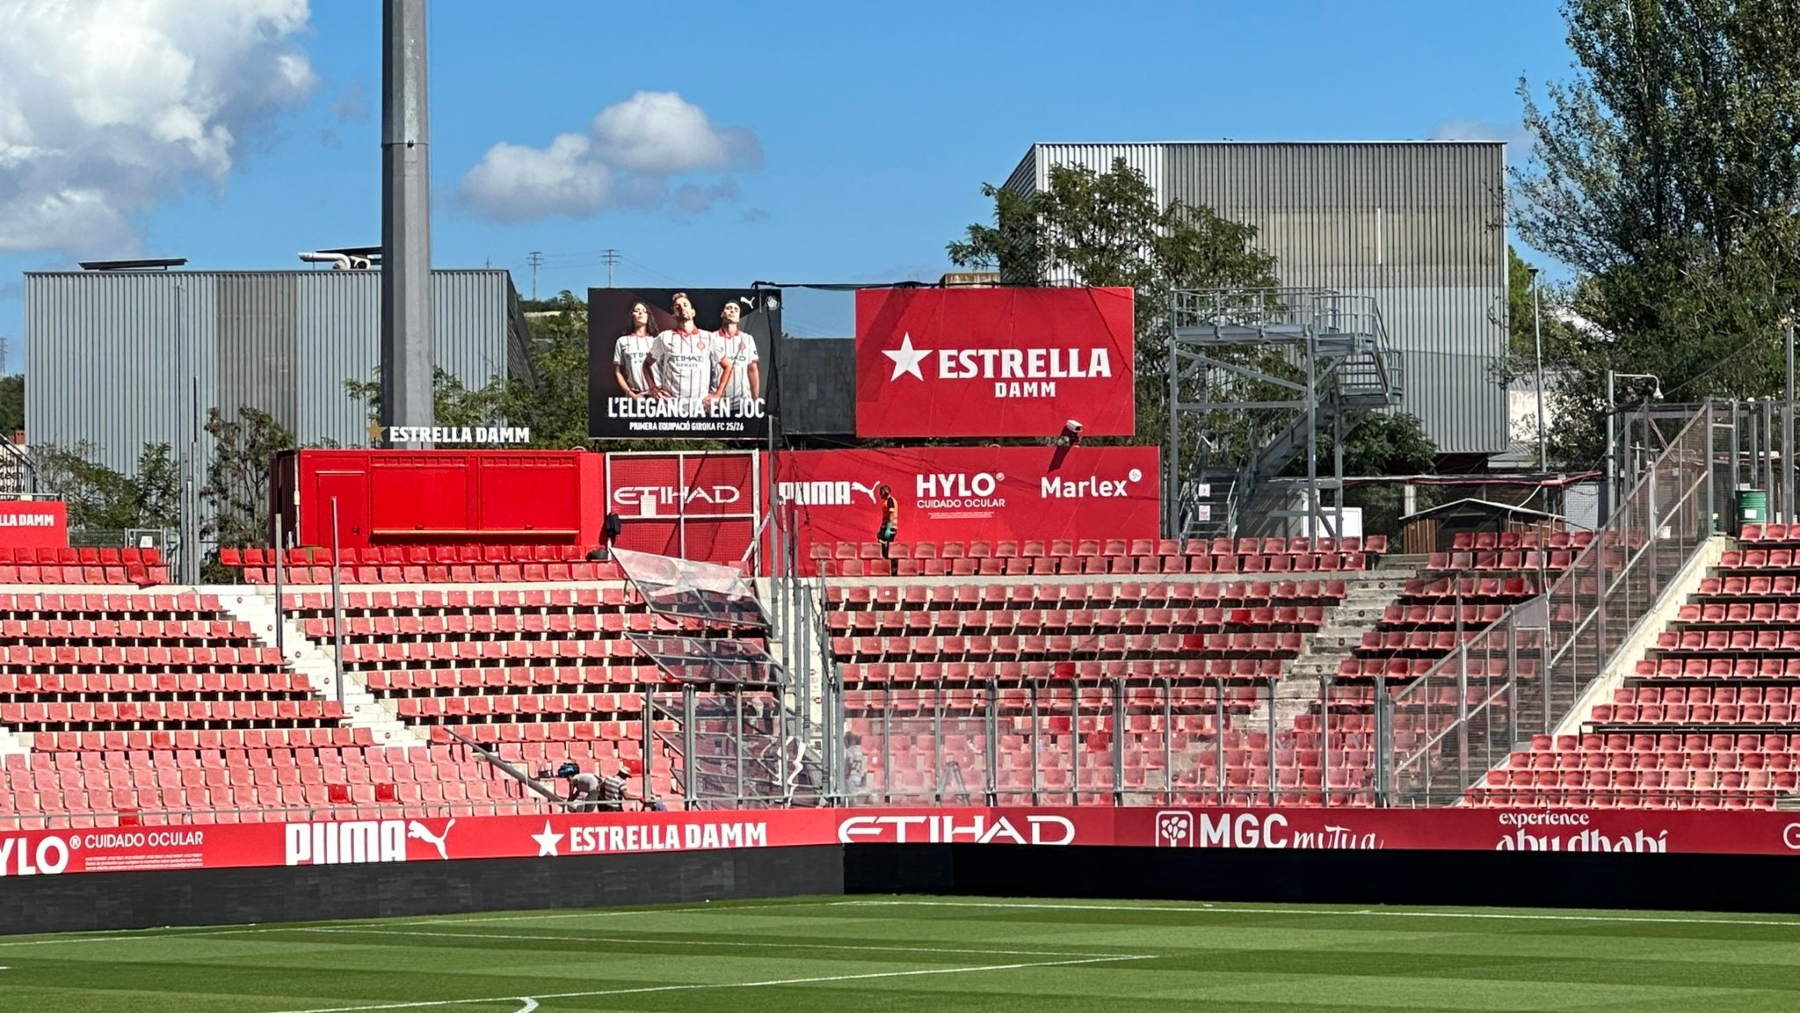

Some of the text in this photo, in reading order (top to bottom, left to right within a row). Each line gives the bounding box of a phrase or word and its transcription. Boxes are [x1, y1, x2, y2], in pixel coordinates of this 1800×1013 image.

[938, 348, 1112, 379] ESTRELLA
[994, 382, 1057, 398] DAMM
[608, 397, 766, 418] L'ELEGANCIA EN JOC
[389, 426, 530, 443] ESTRELLA DAMM
[629, 422, 657, 431] PRIMERA
[659, 421, 690, 431] EQUIPACIÓ
[717, 422, 725, 431] FC
[726, 422, 744, 431] 25/26
[614, 485, 740, 504] ETIHAD
[778, 481, 850, 505] PUMA
[1041, 475, 1128, 498] Marlex
[917, 498, 1005, 509] CUIDADO OCULAR
[19, 514, 54, 527] DAMM
[1499, 810, 1590, 828] experience
[85, 831, 204, 849] CUIDADO OCULAR
[570, 822, 767, 852] ESTRELLA DAMM
[838, 815, 1076, 845] ETIHAD
[1200, 813, 1288, 848] MGC
[285, 820, 406, 866] PUMA
